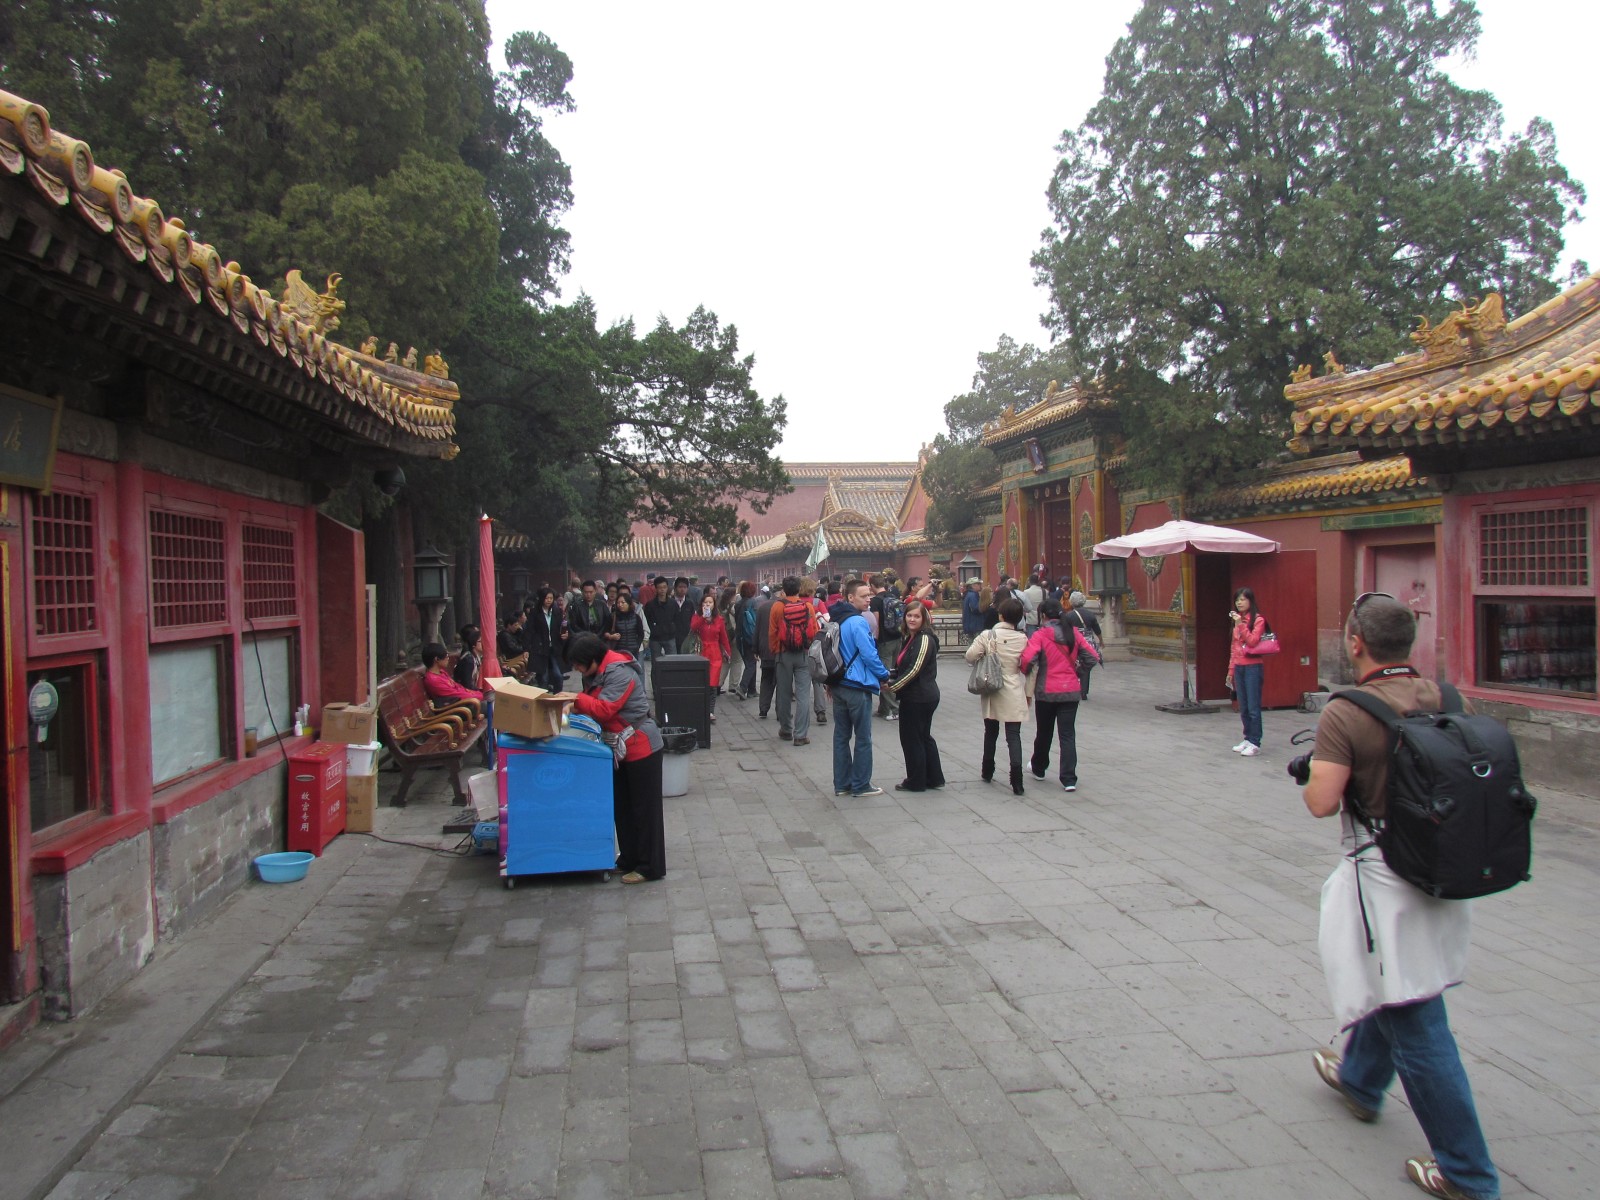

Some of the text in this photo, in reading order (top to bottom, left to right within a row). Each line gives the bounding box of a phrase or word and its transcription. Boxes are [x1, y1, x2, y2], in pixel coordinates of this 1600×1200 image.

[1383, 667, 1410, 675] Canon
[299, 791, 311, 833] 故宫专用
